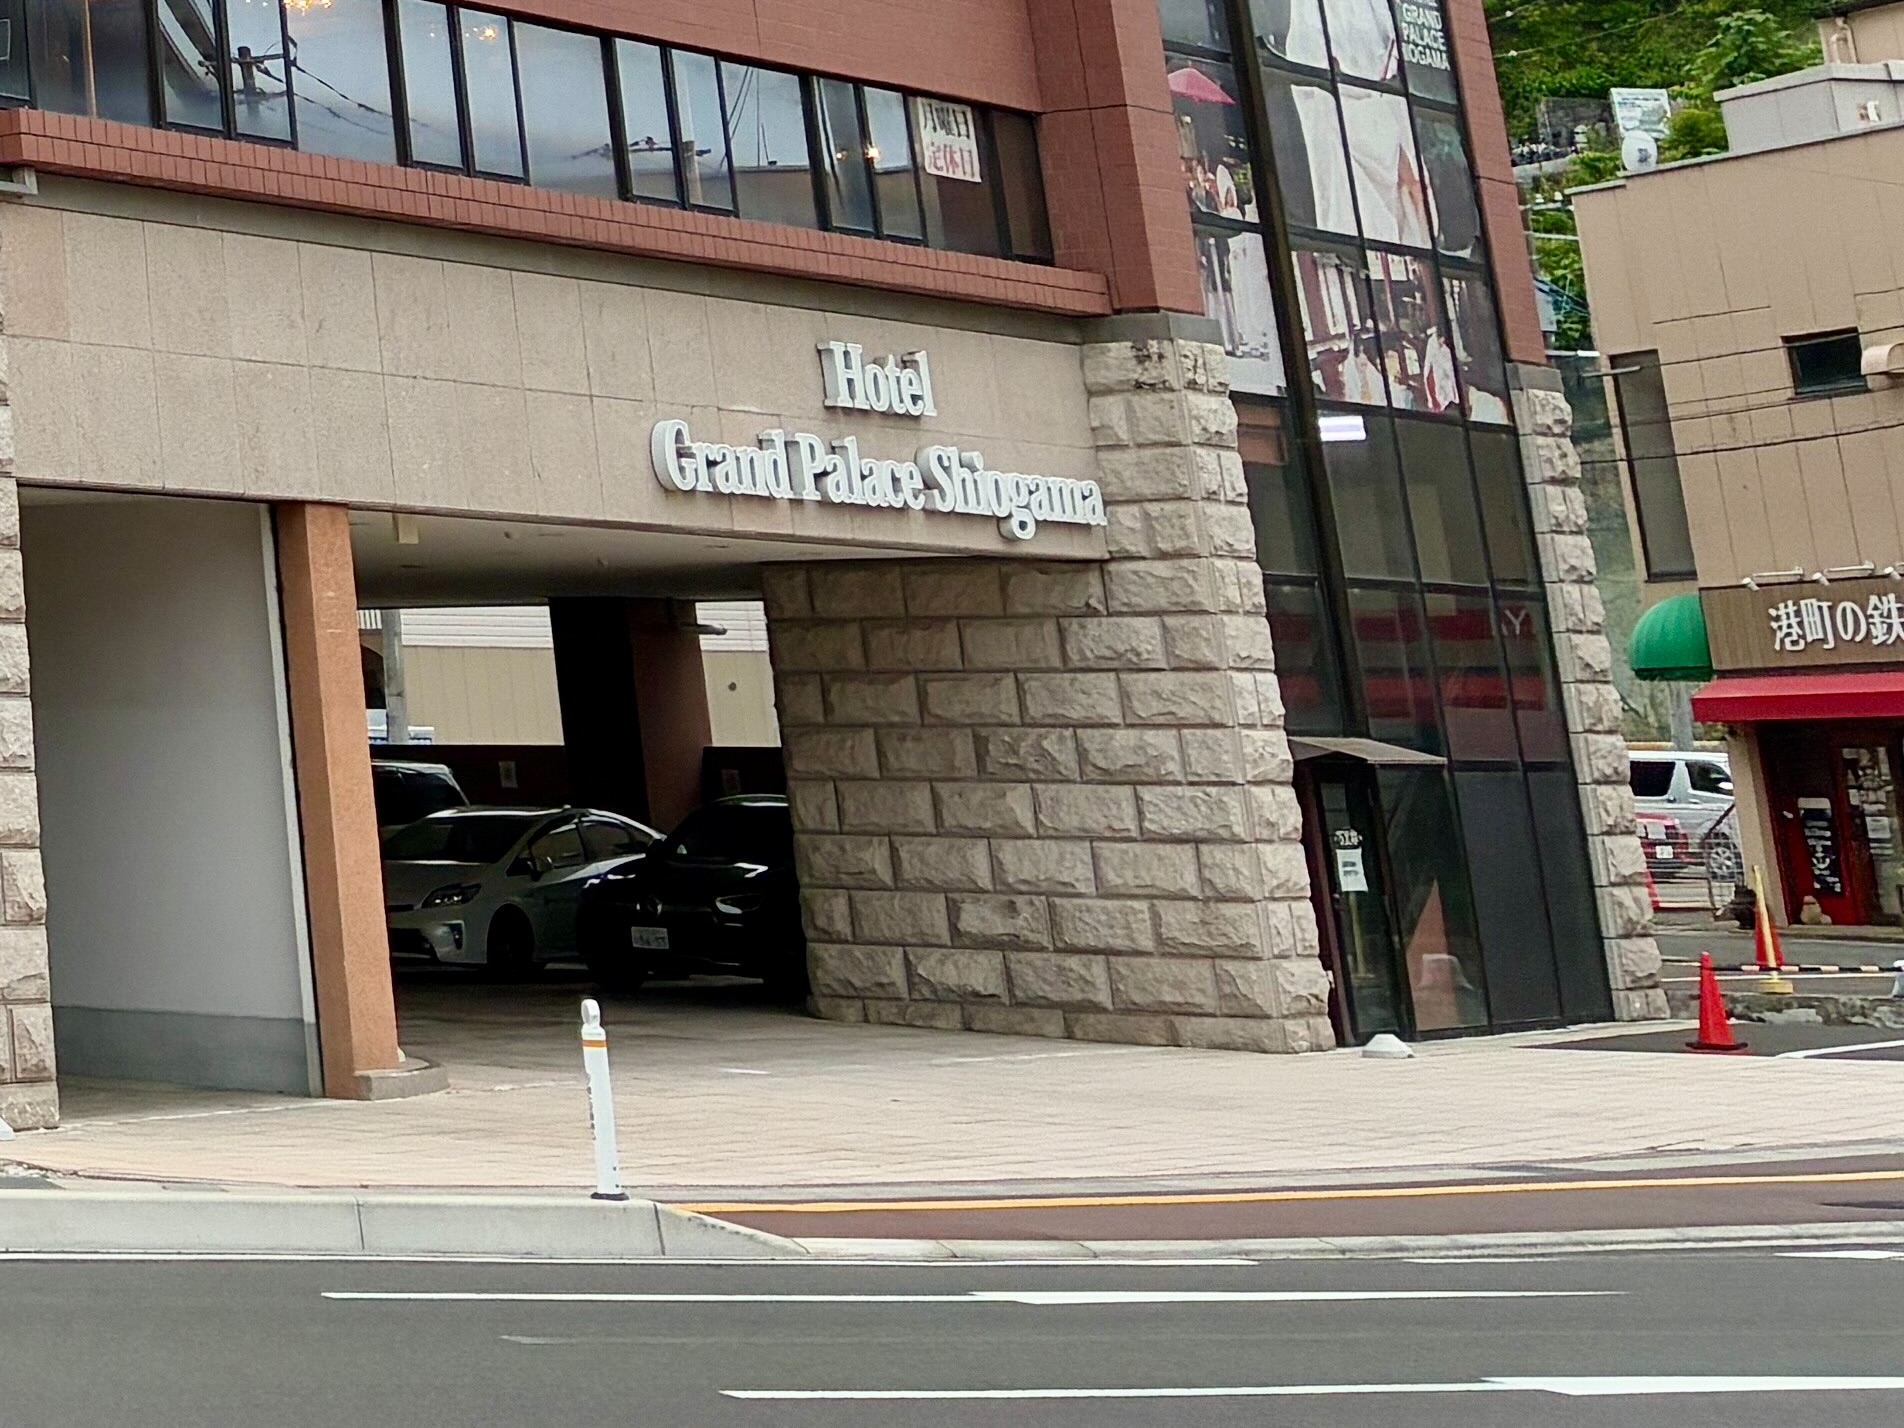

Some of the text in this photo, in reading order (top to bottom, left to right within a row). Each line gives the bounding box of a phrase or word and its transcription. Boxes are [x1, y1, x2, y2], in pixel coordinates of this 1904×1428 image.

[1401, 22, 1447, 51] PALACE
[1402, 3, 1443, 30] GRAND
[817, 340, 938, 418] Hotel
[650, 419, 1108, 541] Grand Palace Shiogama
[1768, 593, 1904, 651] 港町の鉄
